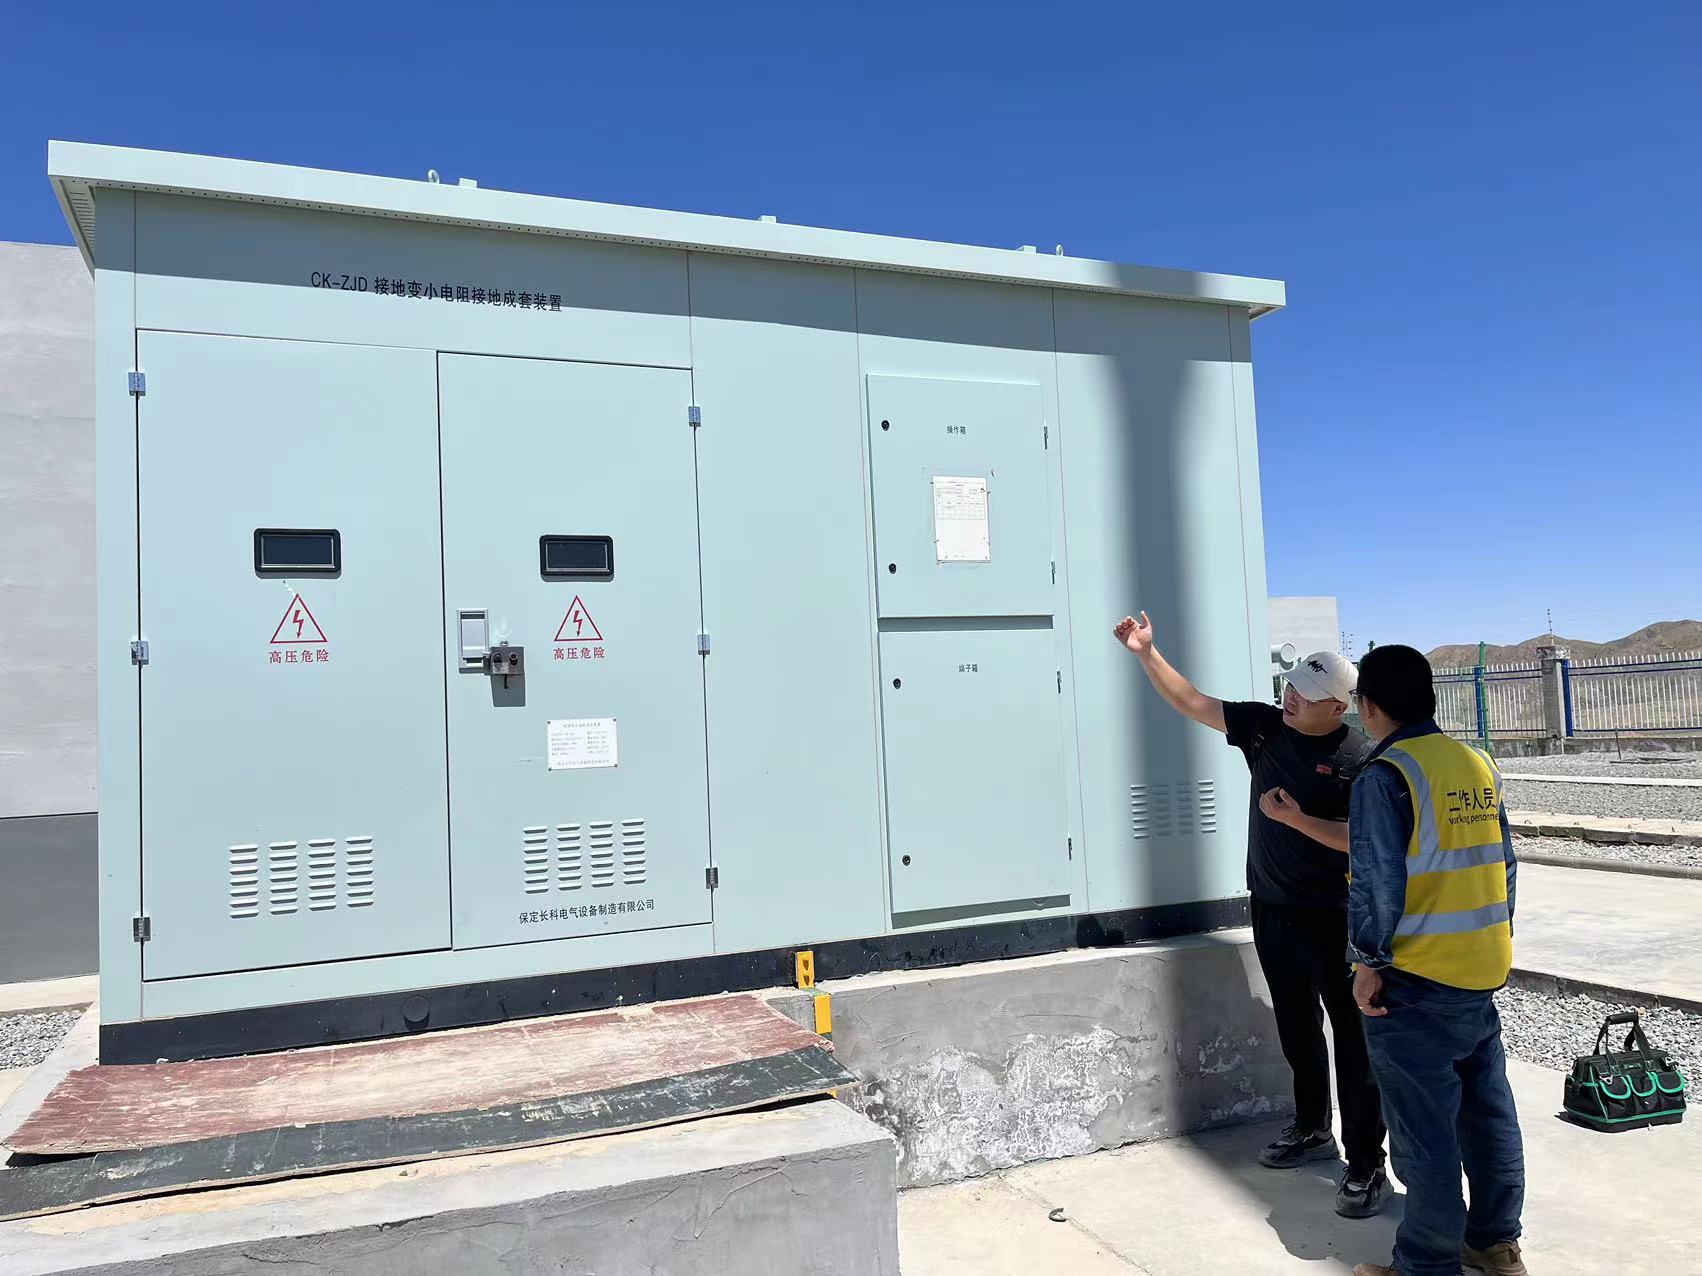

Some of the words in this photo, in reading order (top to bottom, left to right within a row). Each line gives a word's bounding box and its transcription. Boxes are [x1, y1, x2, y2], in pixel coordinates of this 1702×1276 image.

[310, 271, 368, 292] CK-ZJD
[374, 276, 563, 312] 接地变小电阻接地成套装置
[269, 649, 329, 664] 高压危险
[553, 646, 605, 660] 高压危险
[518, 898, 655, 925] 保定长科电气设备制造有限公司
